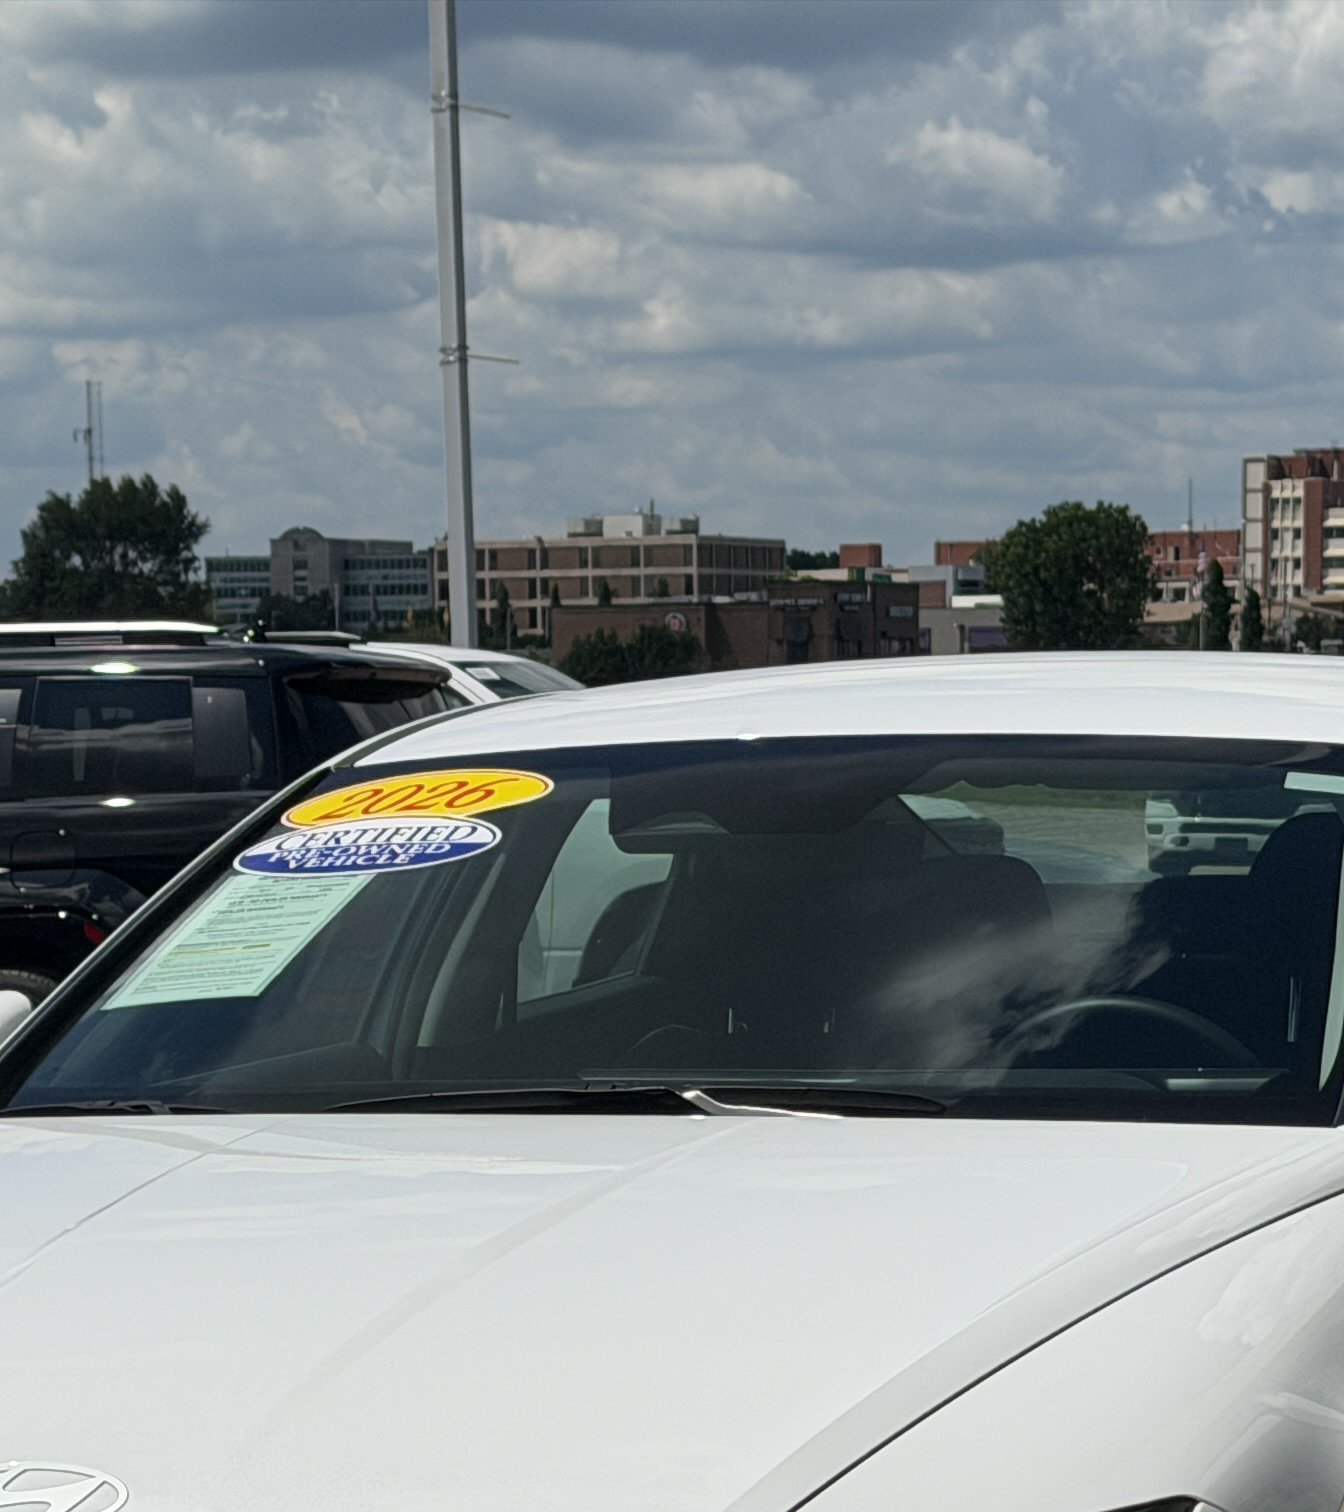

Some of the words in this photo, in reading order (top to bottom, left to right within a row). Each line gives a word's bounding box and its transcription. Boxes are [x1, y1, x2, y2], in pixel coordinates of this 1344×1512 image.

[311, 777, 520, 822] 2026
[276, 825, 479, 851] CERTIFIED
[268, 843, 452, 863] PRE-OWNED
[288, 853, 416, 870] VEHICLE
